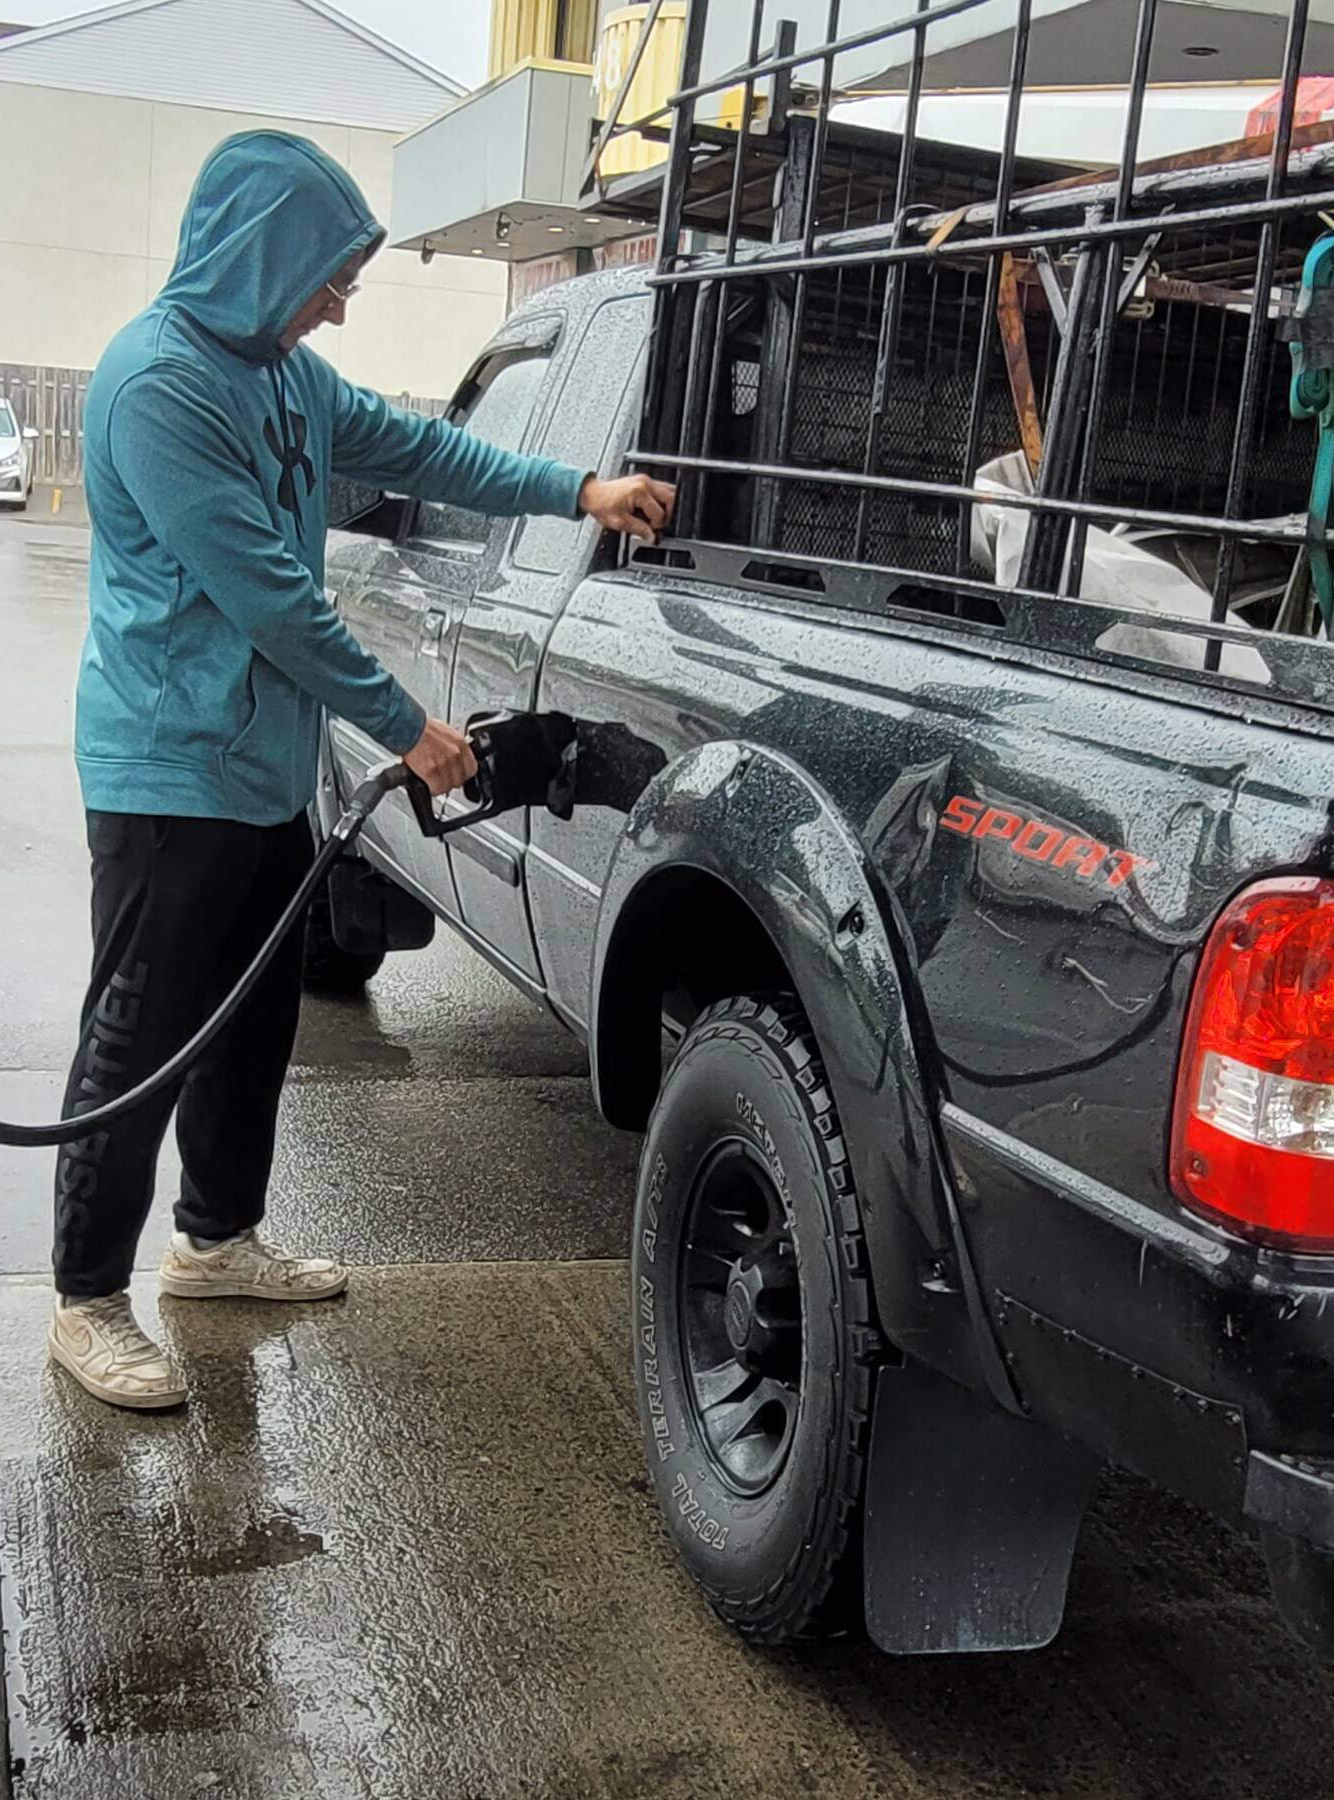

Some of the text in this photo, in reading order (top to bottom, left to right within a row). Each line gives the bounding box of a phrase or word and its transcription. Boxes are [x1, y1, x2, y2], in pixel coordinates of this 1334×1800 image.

[939, 795, 1160, 888] SPORT
[639, 1275, 676, 1463] TERRAIN
[672, 1472, 730, 1552] TOTAL
